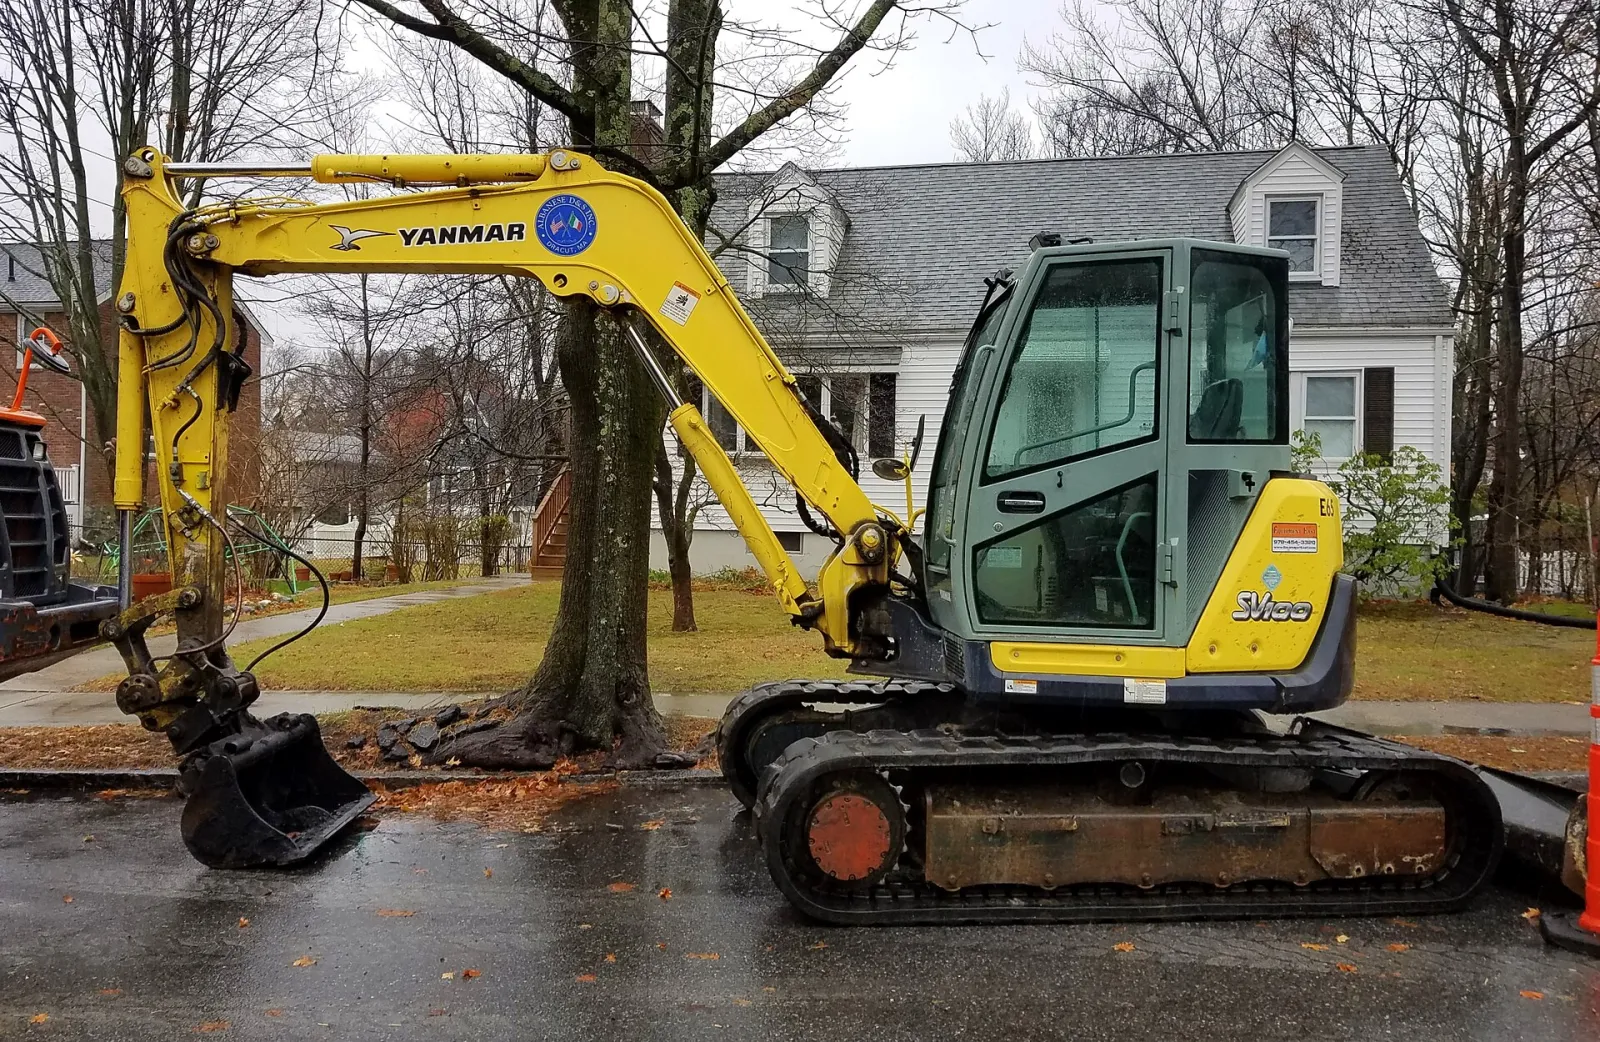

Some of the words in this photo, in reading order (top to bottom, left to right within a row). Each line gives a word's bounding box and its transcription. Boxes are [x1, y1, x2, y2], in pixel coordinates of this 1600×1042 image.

[537, 196, 567, 230] ALBANESE
[569, 196, 588, 211] D&S
[585, 209, 596, 228] INC.
[398, 223, 526, 247] YANMAR
[576, 240, 588, 251] MA
[1319, 497, 1335, 517] E65
[1232, 591, 1312, 622] SV100
